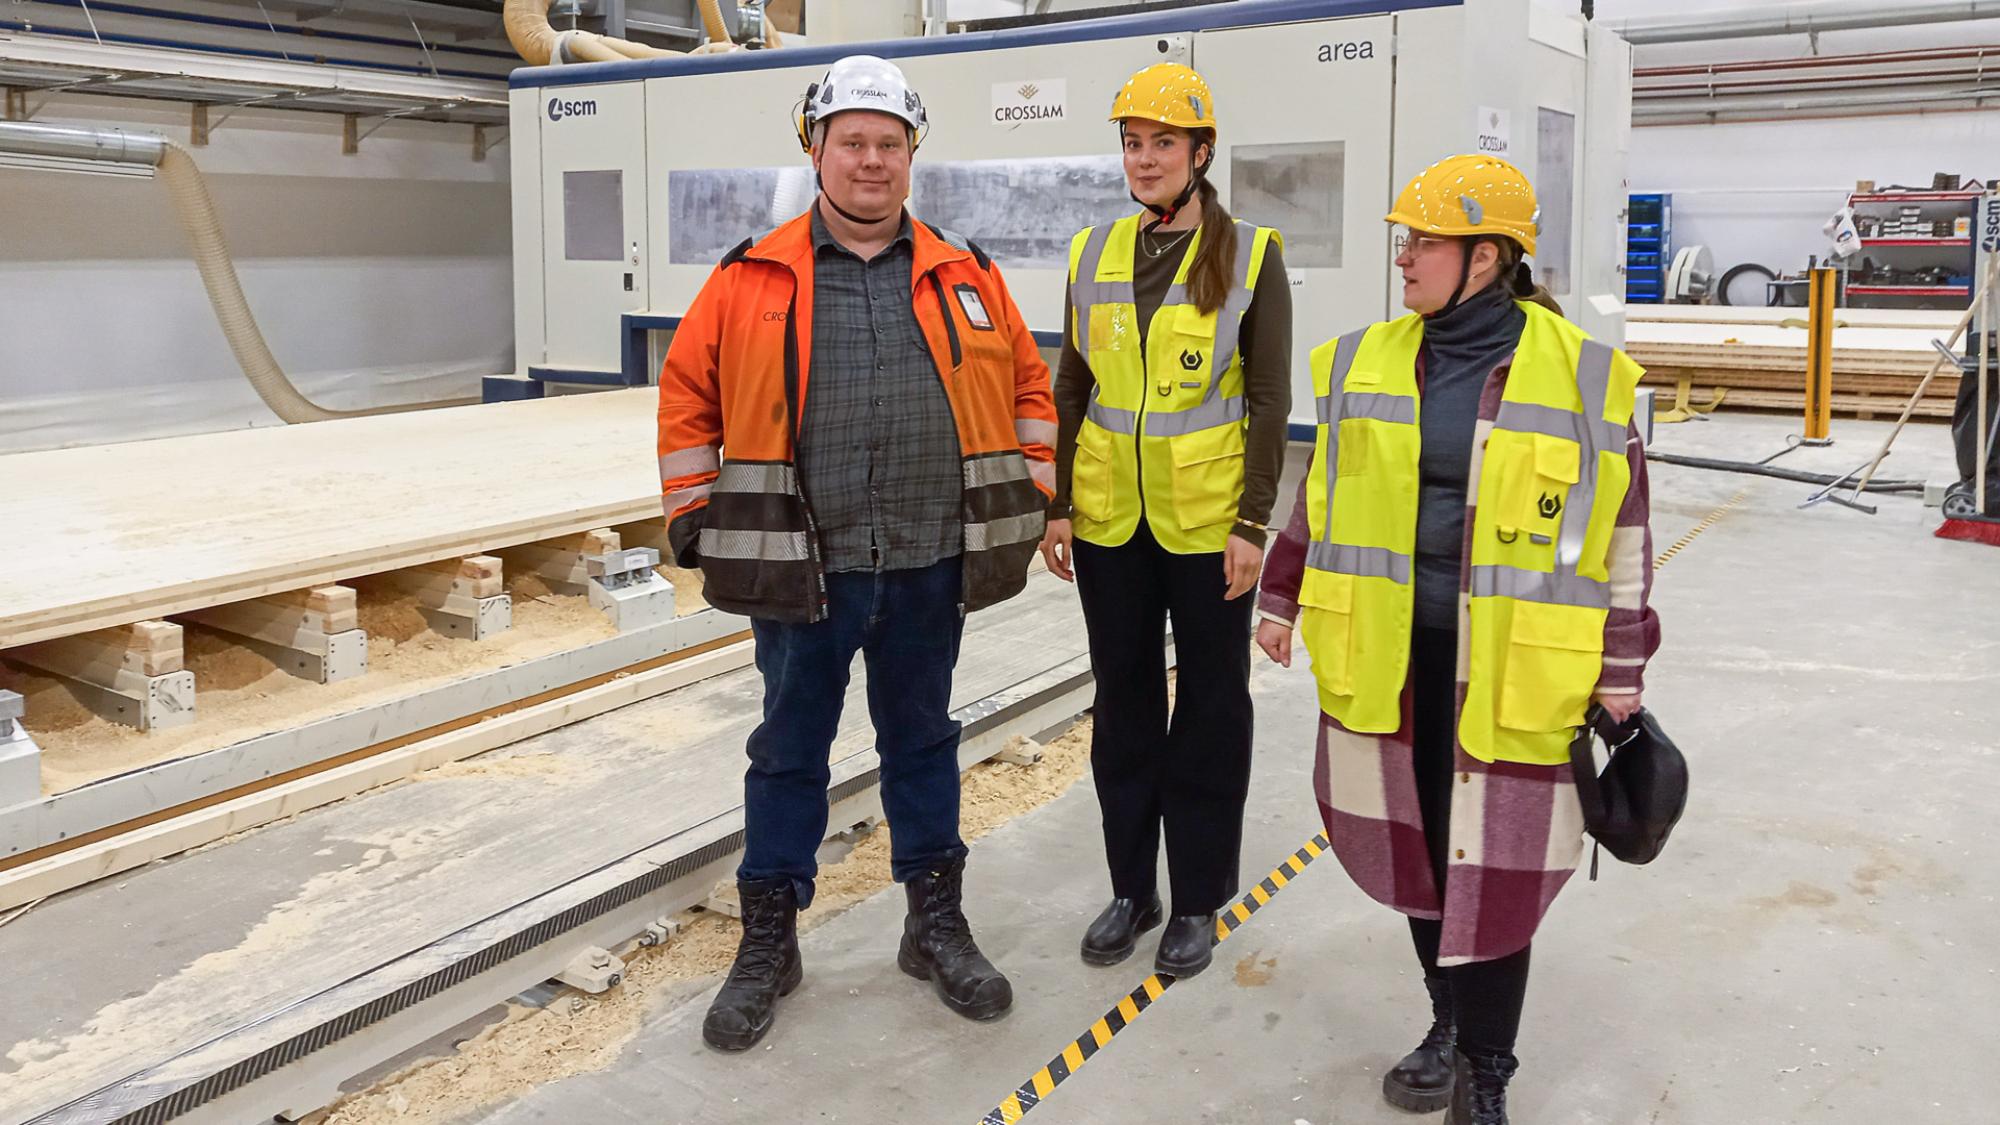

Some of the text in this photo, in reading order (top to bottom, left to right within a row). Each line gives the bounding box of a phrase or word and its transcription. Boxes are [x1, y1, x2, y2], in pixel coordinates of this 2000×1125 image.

[1318, 41, 1374, 62] area
[564, 100, 597, 116] scm
[995, 104, 1063, 121] CROSSLAM
[1987, 200, 2000, 236] scm
